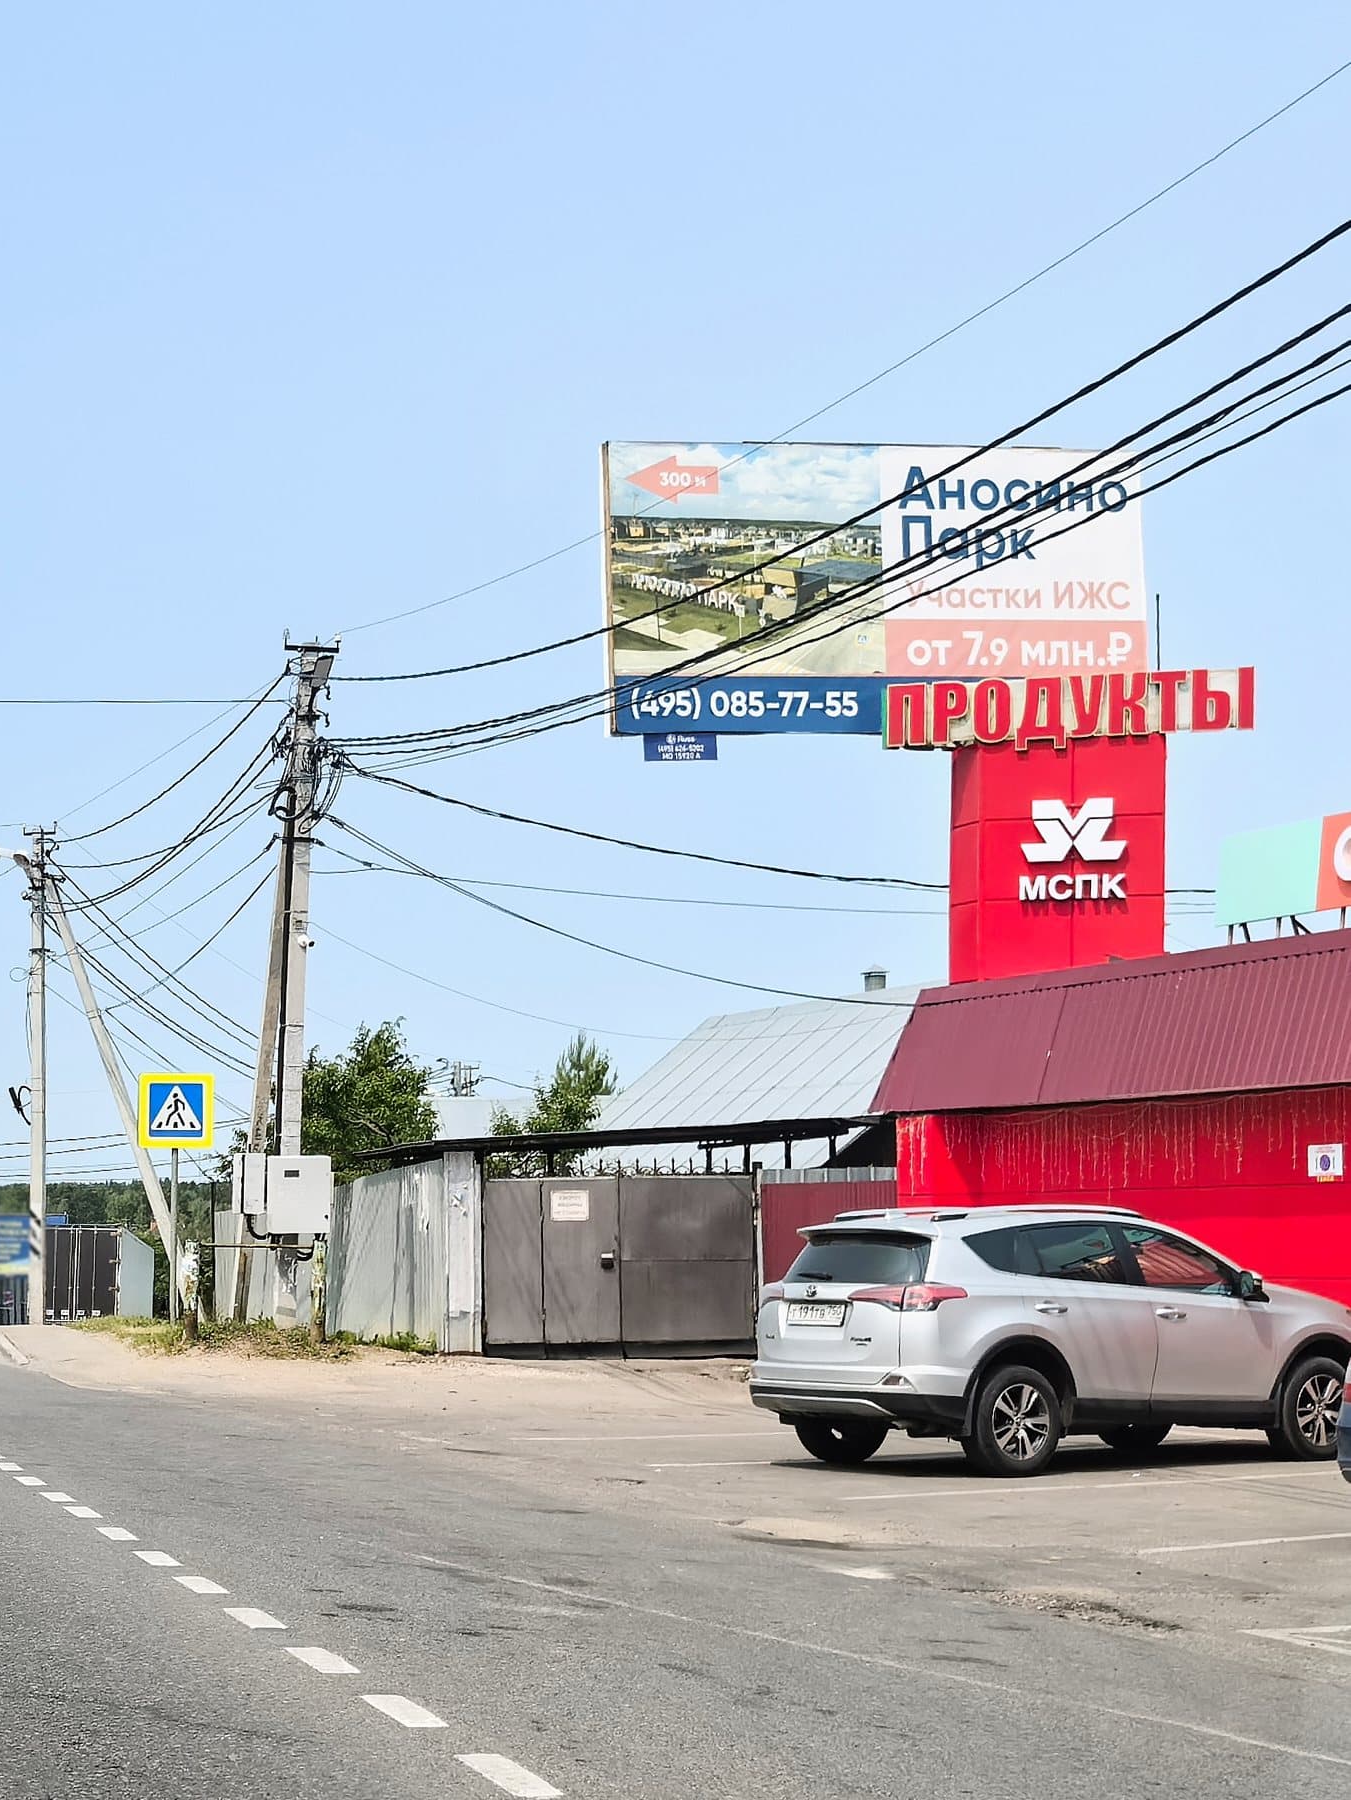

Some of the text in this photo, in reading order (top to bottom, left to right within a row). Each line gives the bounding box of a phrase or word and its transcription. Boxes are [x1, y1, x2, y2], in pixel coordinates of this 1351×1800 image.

[659, 472, 691, 487] 300
[898, 466, 1128, 512] Аносино
[902, 515, 1036, 571] Парк
[905, 580, 1131, 609] Участки ИЖС
[906, 638, 952, 666] от
[962, 630, 1008, 666] 7.9
[631, 687, 858, 719] (495) 085-77-55
[886, 666, 1255, 751] ПРОДУКТЫ
[1018, 873, 1127, 901] МСПК
